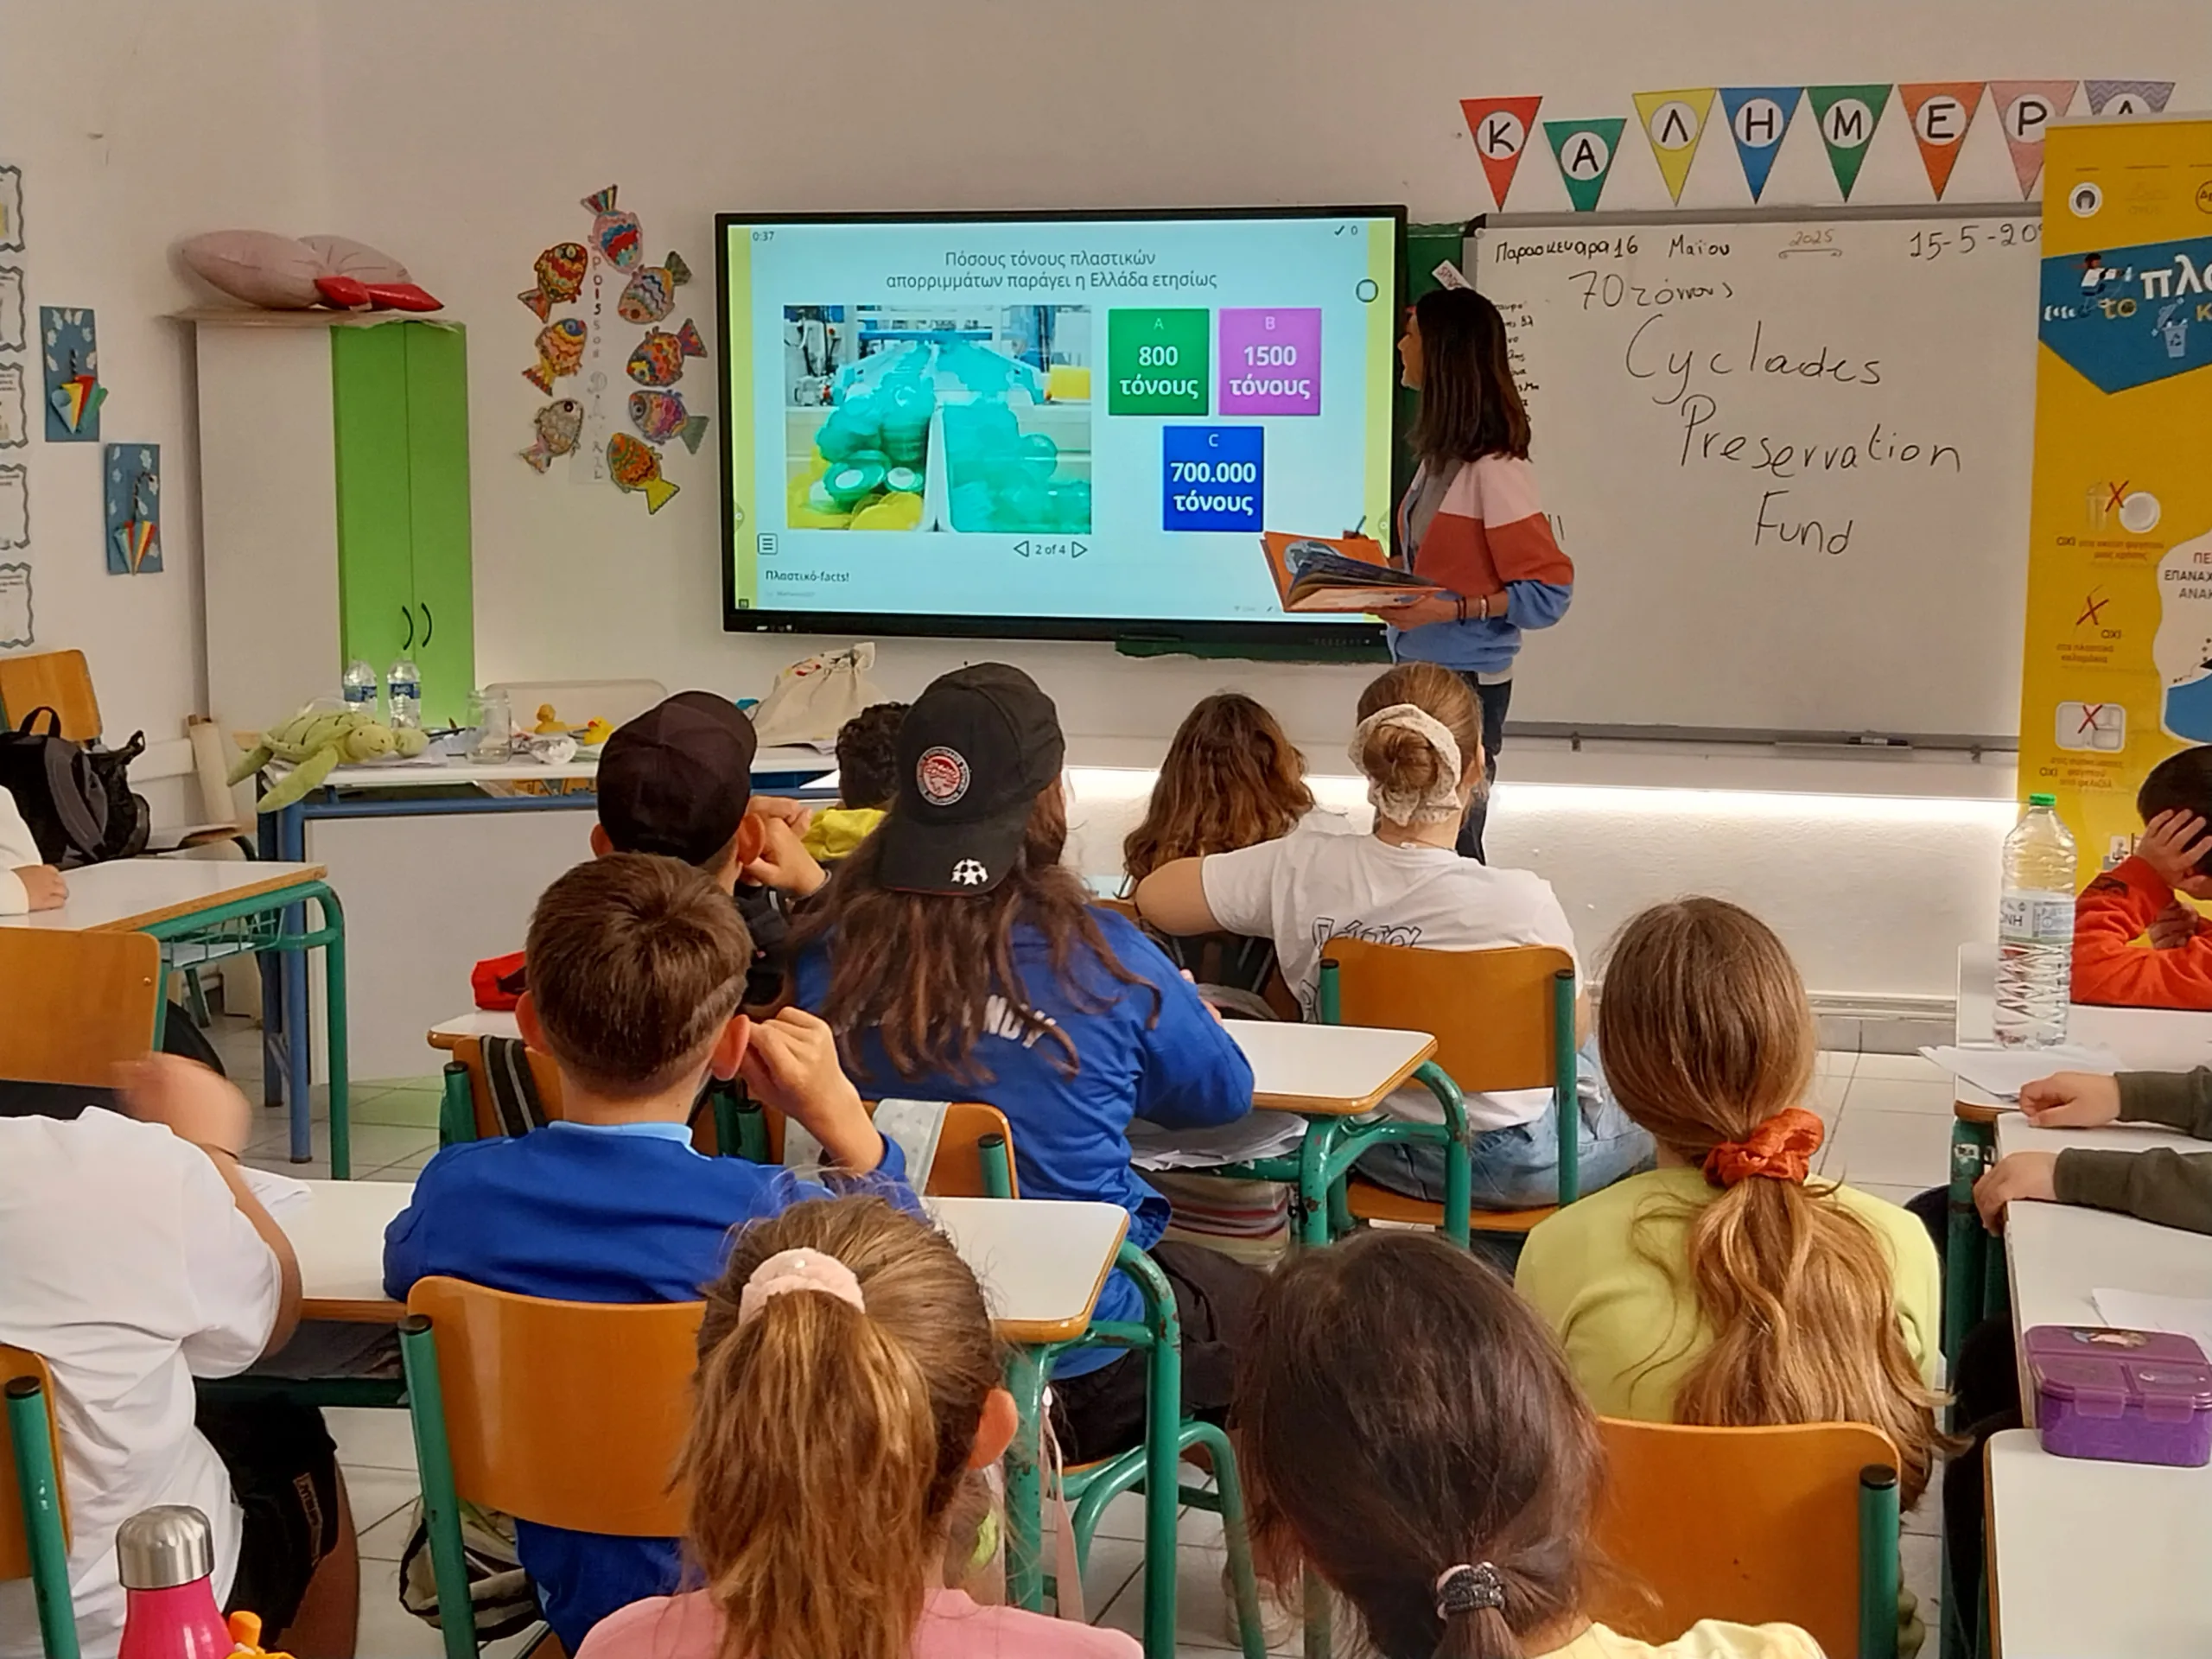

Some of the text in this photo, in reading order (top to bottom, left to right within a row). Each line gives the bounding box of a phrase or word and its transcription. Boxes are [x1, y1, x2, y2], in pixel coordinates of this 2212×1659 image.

[752, 231, 775, 242] 0:37
[1351, 226, 1358, 236] 0
[1789, 228, 1835, 247] 2025
[1910, 223, 2043, 260] 15-5-20
[945, 249, 1156, 267] Πόσους τόνους πλαστικών
[887, 270, 1217, 291] απορριμμάτων παράγει η Ελλάδα ετησίως
[1568, 270, 1624, 310] 70
[1154, 318, 1164, 330] A
[1265, 316, 1276, 330] B
[1138, 346, 1179, 366] 800
[1244, 346, 1297, 366] 1500
[1625, 313, 1881, 404] Cyclades
[1120, 373, 1199, 400] τόνους
[1230, 373, 1311, 400] τόνους
[1208, 434, 1219, 448] C
[1681, 394, 1961, 478] Preservation
[1170, 462, 1257, 484] 700.000
[1173, 489, 1255, 516] τόνους
[1754, 489, 1853, 555] Fund
[1035, 543, 1066, 555] 2 of 4
[766, 570, 849, 582] Πλαστικό-facts!
